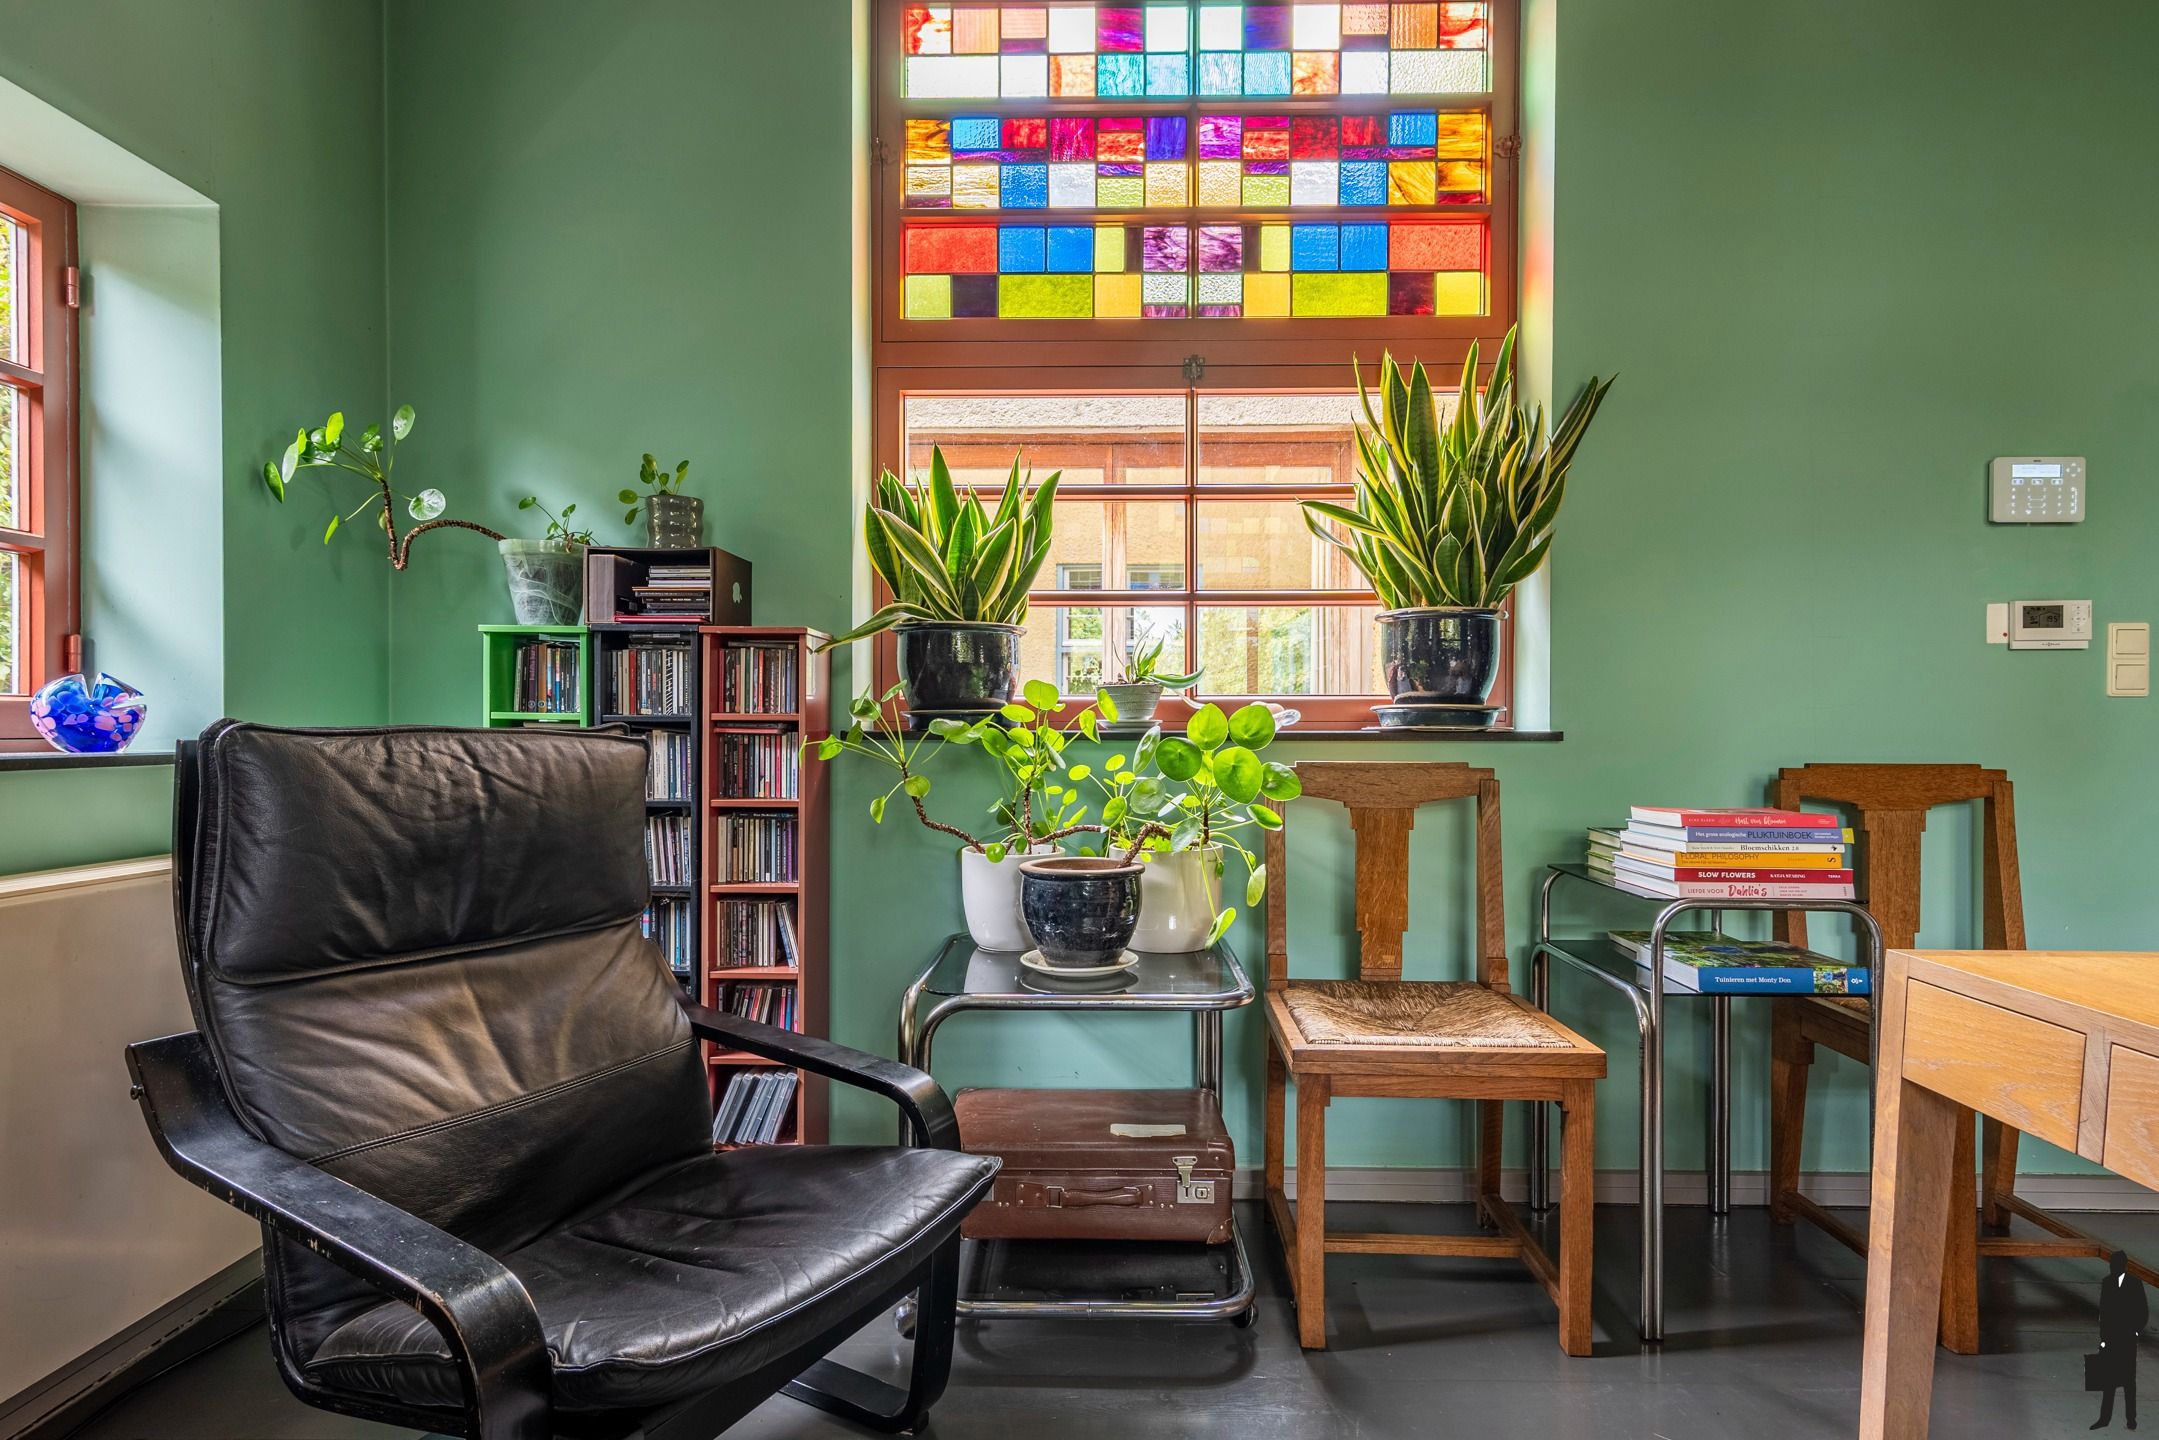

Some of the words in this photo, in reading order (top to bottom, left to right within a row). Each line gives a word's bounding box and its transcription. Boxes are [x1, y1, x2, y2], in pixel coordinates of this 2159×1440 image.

[1747, 831, 1812, 839] PLUKTUINBOEK
[1728, 883, 1767, 897] Dahlia's
[1758, 976, 1778, 984] Monty
